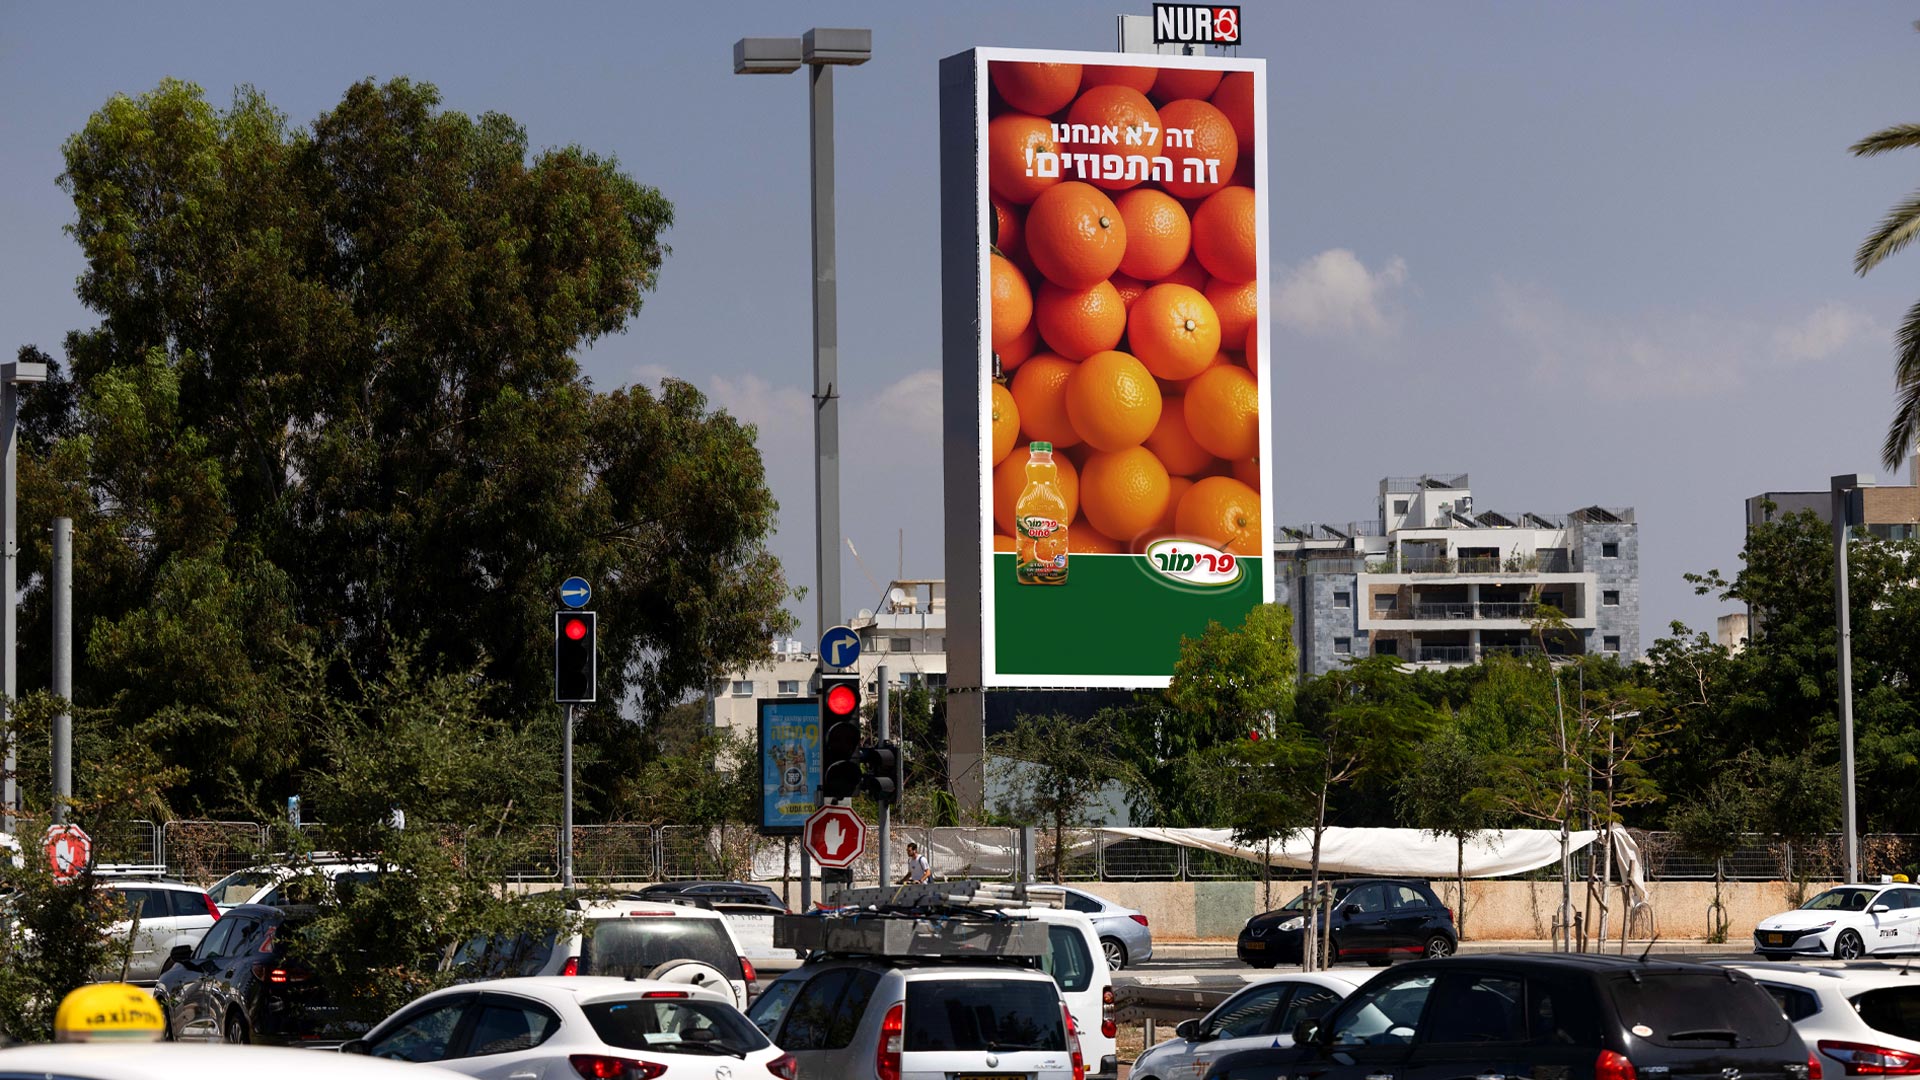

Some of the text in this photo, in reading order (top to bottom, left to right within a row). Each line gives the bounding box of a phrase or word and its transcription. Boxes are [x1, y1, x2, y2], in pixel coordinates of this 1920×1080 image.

[1157, 6, 1212, 41] NUR
[1050, 121, 1195, 149] זה לא אנחנו
[1025, 147, 1221, 184] זה התפוזים!
